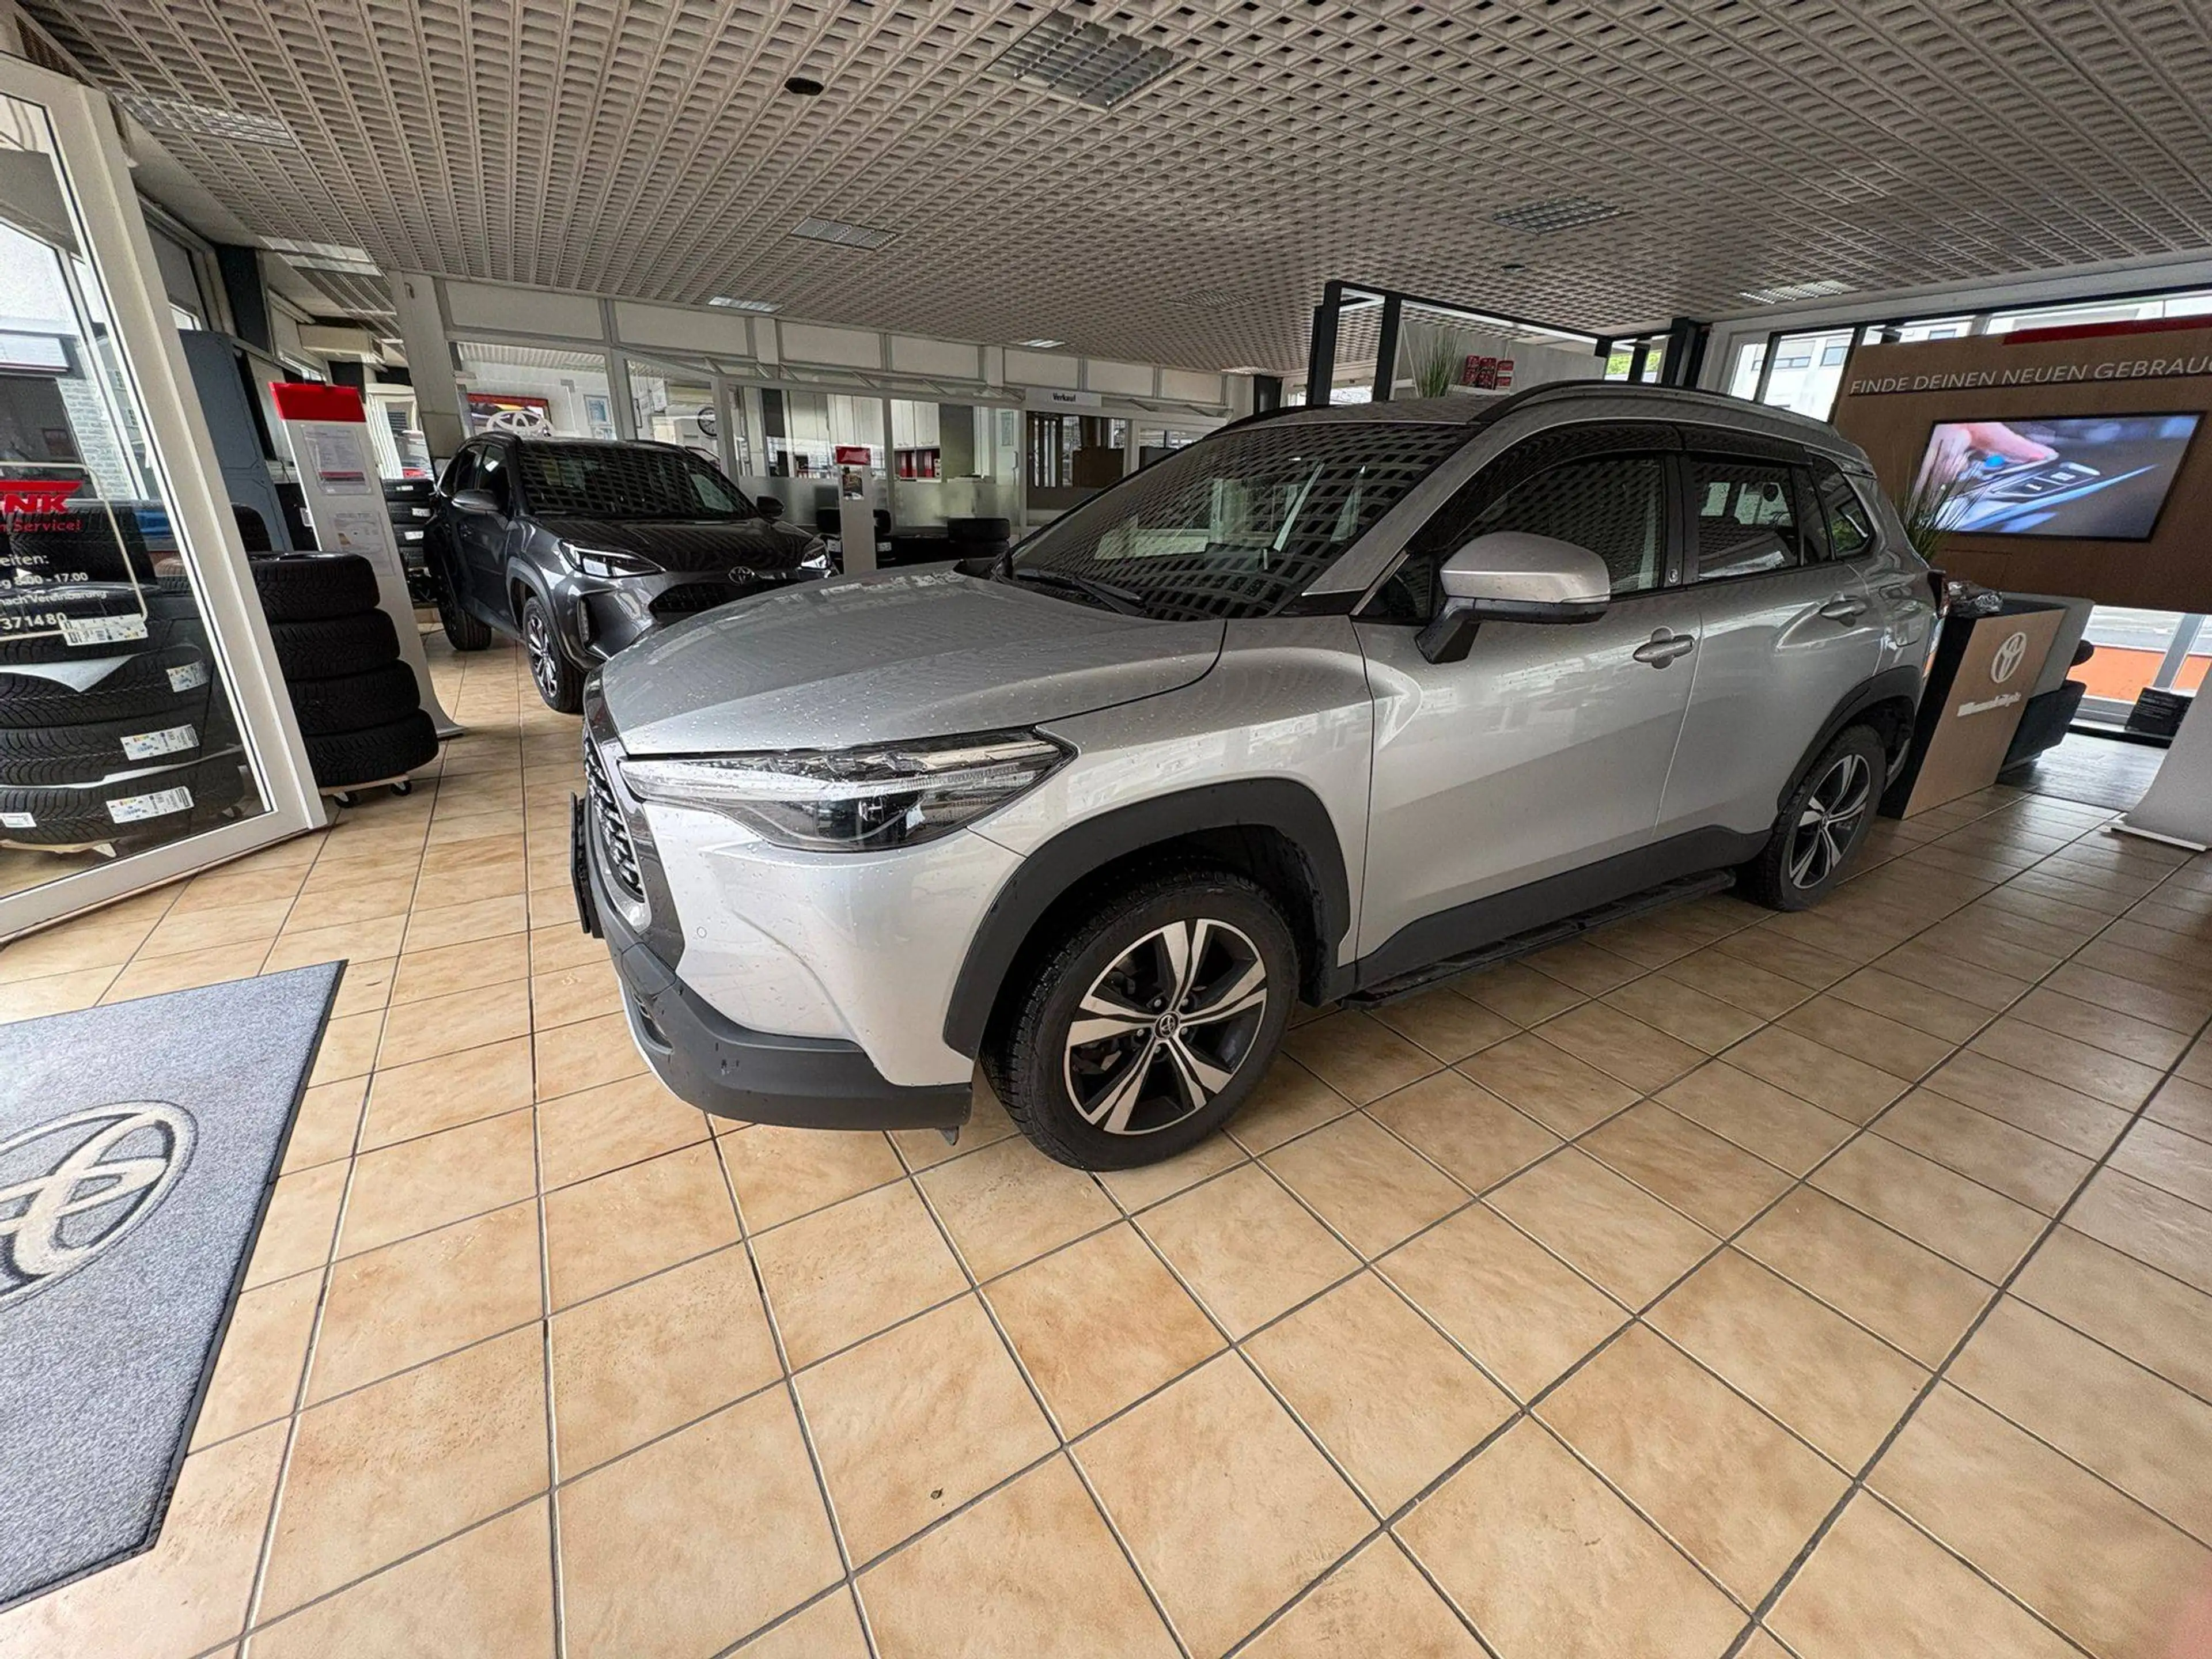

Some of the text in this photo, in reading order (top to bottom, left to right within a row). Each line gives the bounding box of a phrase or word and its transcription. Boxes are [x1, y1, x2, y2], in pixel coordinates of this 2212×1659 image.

[1849, 355, 2212, 395] FINDE DEINEN NEUEN GEBRAU
[13, 518, 82, 532] Service!
[0, 554, 50, 567] eiten:
[54, 572, 89, 583] 17.00
